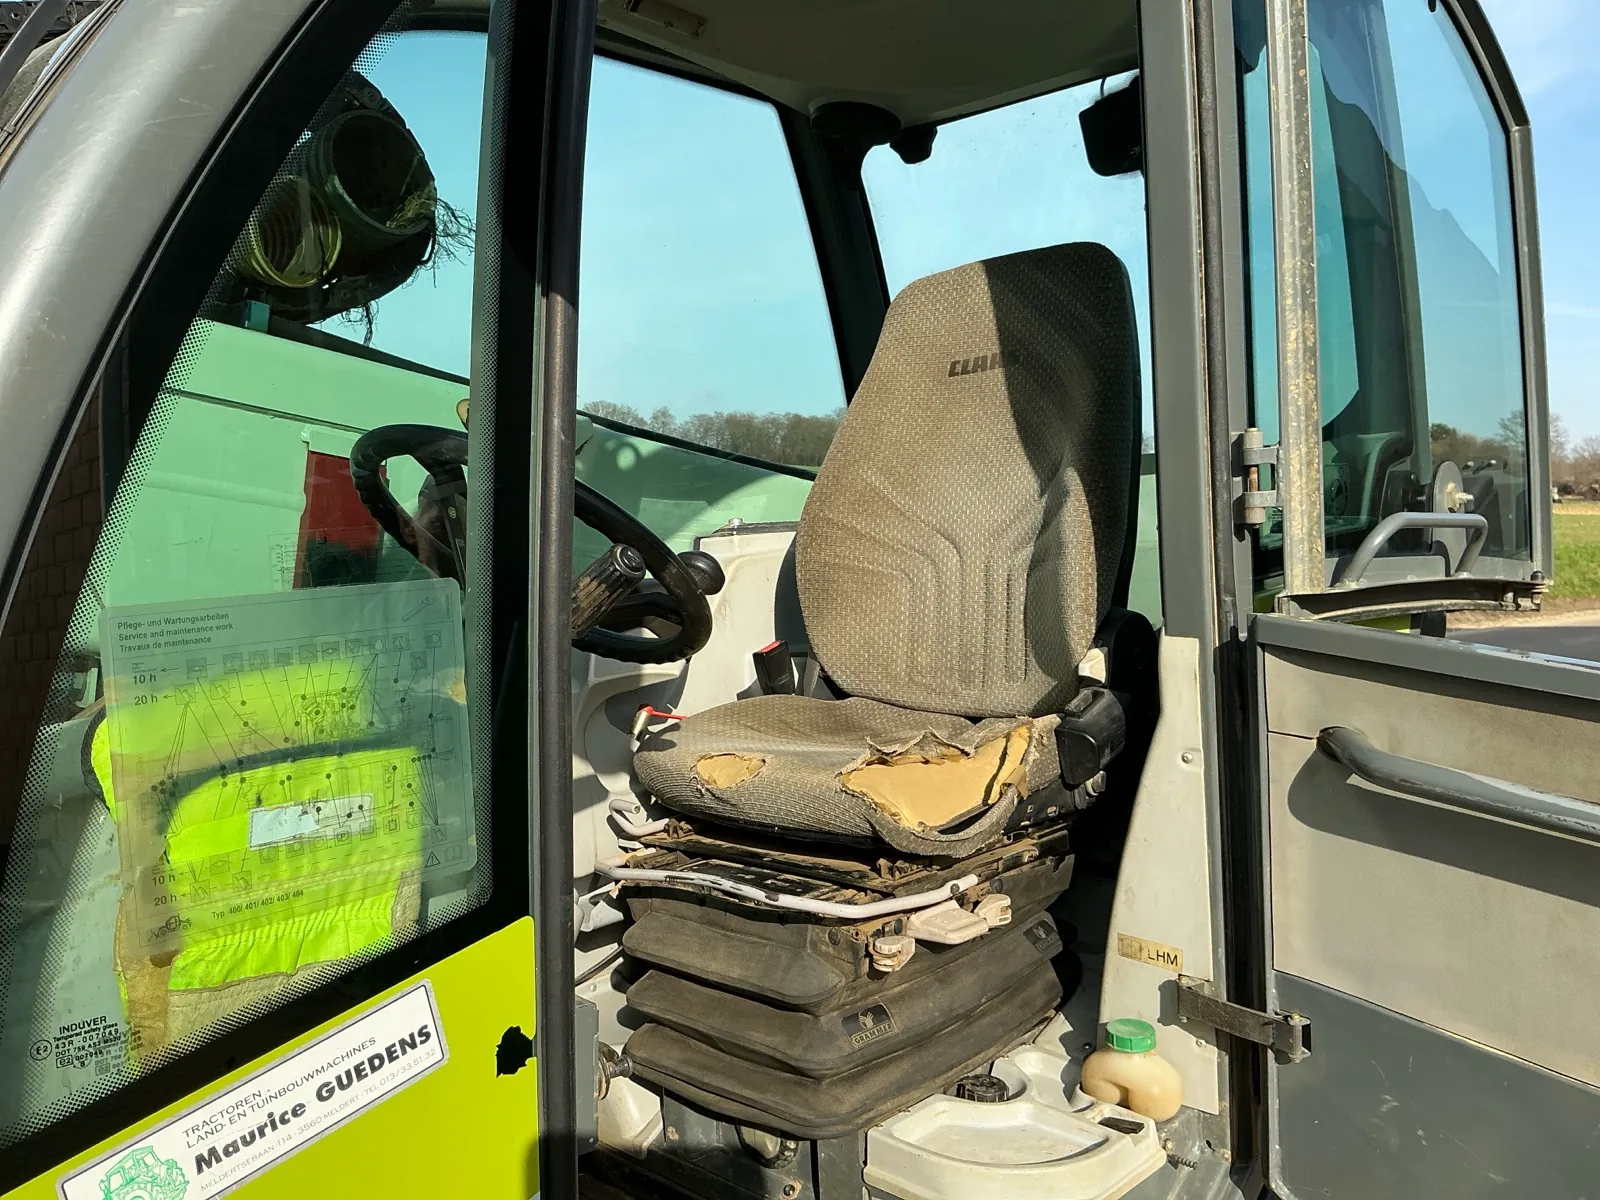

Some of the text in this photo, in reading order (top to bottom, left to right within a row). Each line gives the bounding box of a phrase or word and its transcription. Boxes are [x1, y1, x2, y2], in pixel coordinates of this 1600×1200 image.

[118, 613, 230, 630] Pflege- und Wartungsarbeiten
[119, 632, 148, 641] Service
[150, 629, 164, 637] and
[166, 626, 213, 636] maintenance
[120, 643, 150, 652] Travaux
[164, 637, 211, 647] maintenance
[132, 673, 156, 684] 10 h
[134, 694, 158, 706] 20 h
[152, 873, 175, 886] 10 h
[154, 893, 177, 906] 20 h
[212, 911, 225, 920] Typ
[292, 889, 304, 898] 404
[1147, 948, 1178, 967] LHM
[53, 1022, 118, 1042] Tempered safety glass
[59, 1015, 107, 1035] INDUVER
[854, 1023, 893, 1044] GRAMMER
[36, 1045, 49, 1055] E2
[55, 1049, 71, 1057] DOT
[186, 1036, 377, 1149] LAND- EN TUINBOUWMACHINES
[194, 1024, 432, 1176] Maurice GUEDENS
[200, 1144, 275, 1192] MELDERTSEBAAN
[323, 1095, 361, 1120] MELDERT
